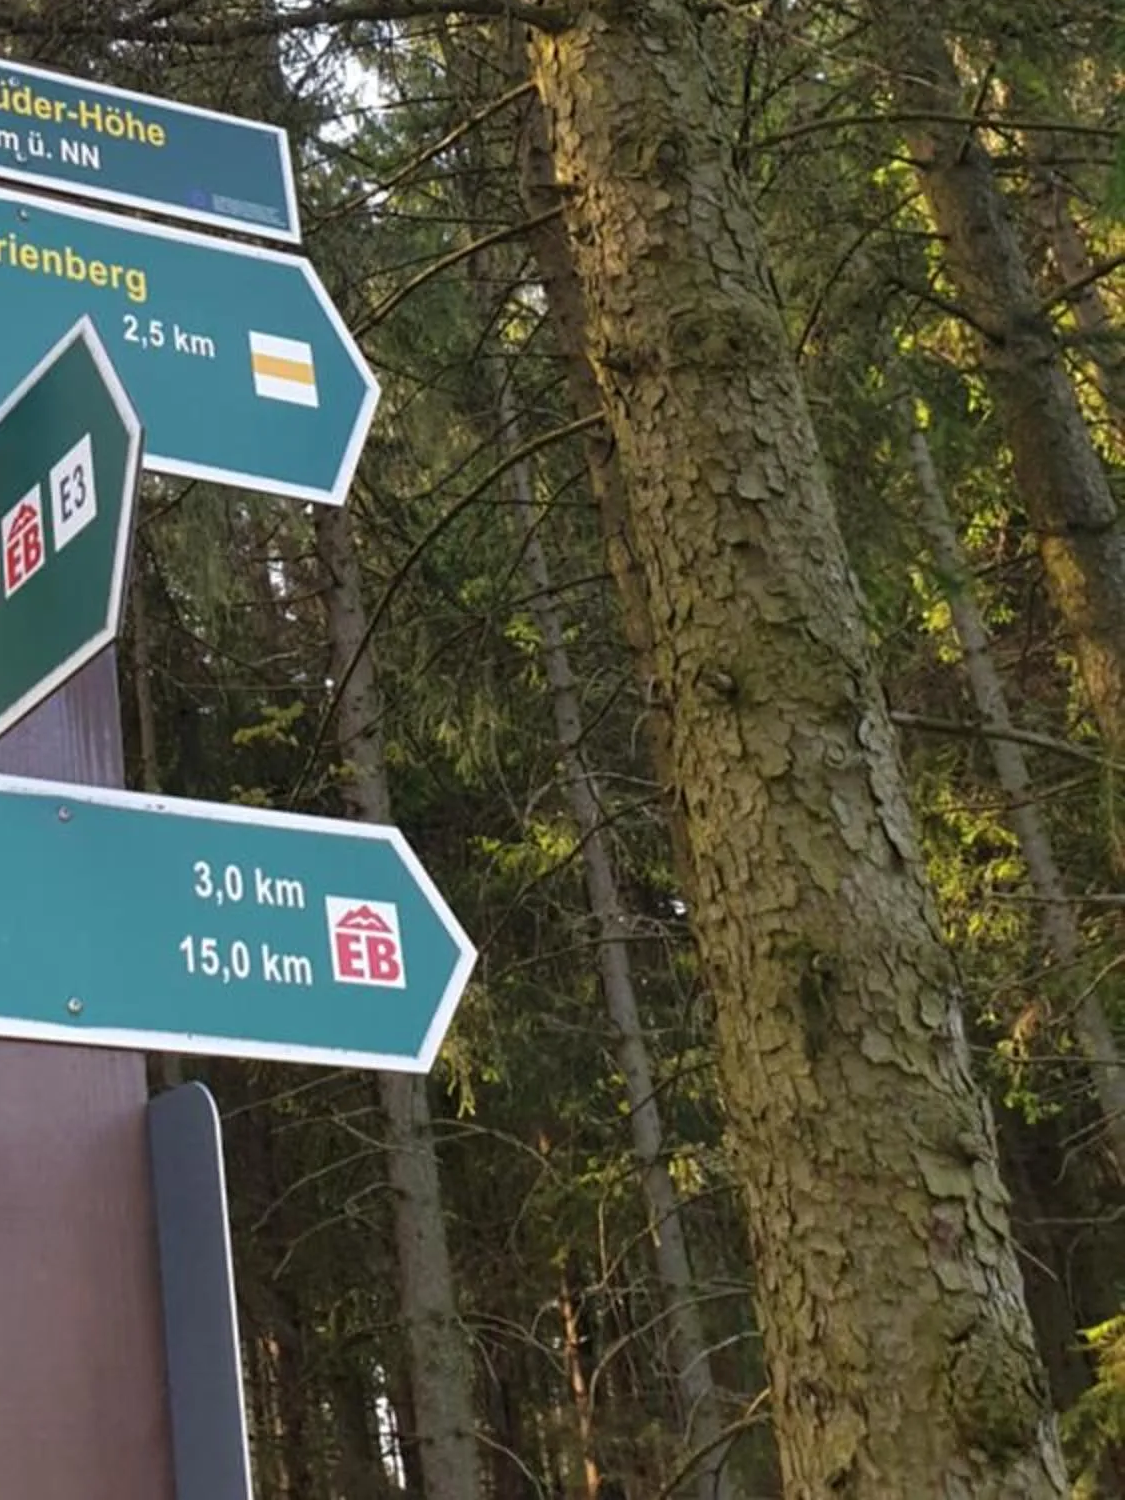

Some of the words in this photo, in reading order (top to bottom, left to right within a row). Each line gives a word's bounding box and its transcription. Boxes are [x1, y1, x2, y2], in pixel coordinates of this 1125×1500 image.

[29, 129, 53, 159] ü.
[61, 139, 101, 171] NN
[123, 314, 165, 349] 2,5
[174, 324, 216, 358] km
[59, 464, 87, 524] E3
[6, 530, 42, 590] EB
[193, 861, 243, 906] 3,0
[254, 867, 305, 909] km
[179, 935, 250, 985] 15,0
[261, 944, 313, 986] km
[335, 932, 401, 982] EB
